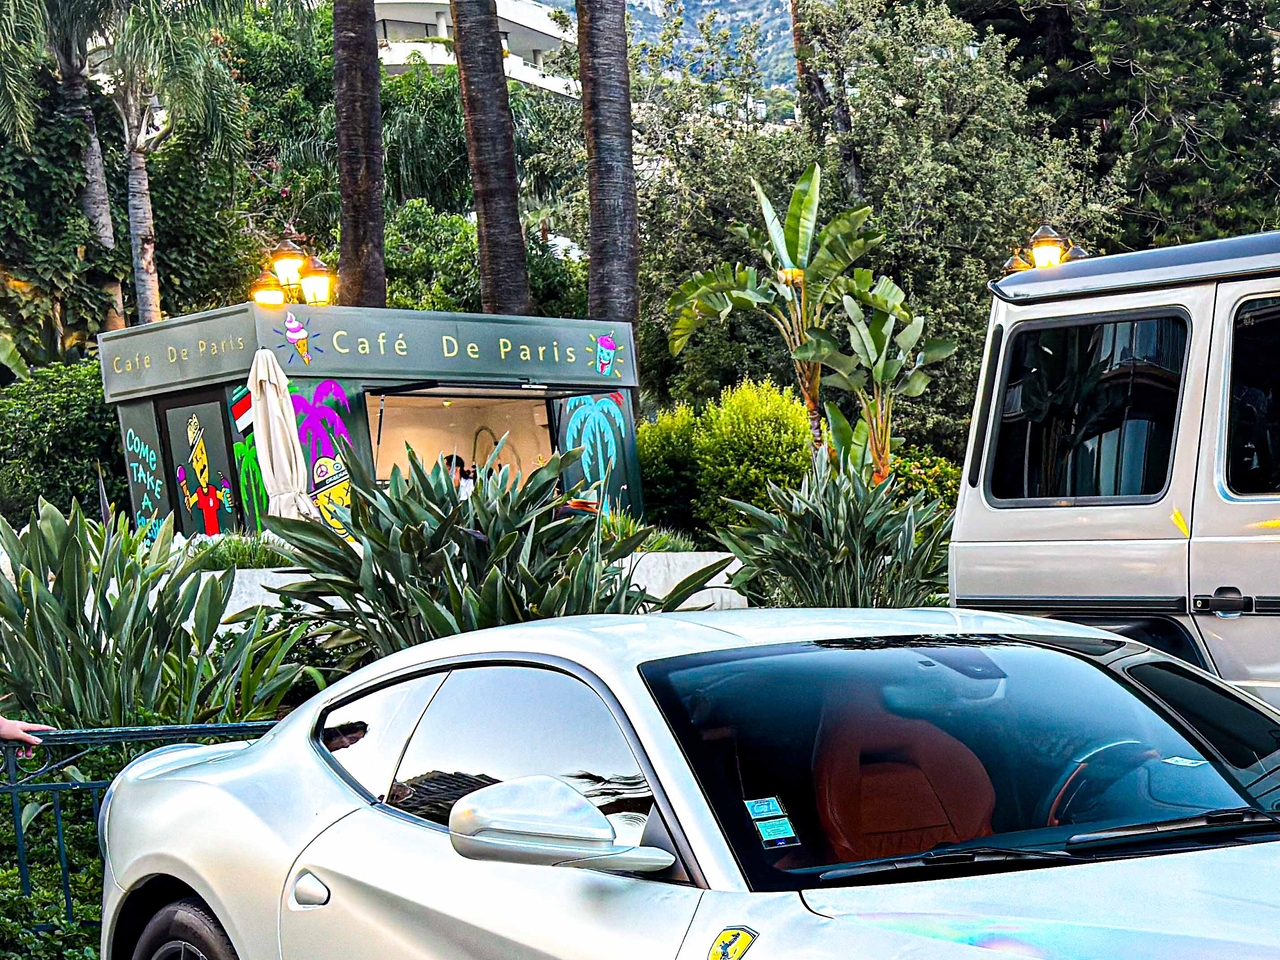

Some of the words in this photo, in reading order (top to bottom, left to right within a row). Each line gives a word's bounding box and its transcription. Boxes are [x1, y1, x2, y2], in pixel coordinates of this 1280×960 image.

[113, 351, 151, 374] Café
[167, 346, 189, 363] De
[198, 335, 244, 357] Paris
[331, 330, 407, 356] Café
[441, 335, 480, 359] De
[499, 338, 577, 363] Paris
[130, 462, 163, 500] TAKE
[141, 492, 153, 512] A
